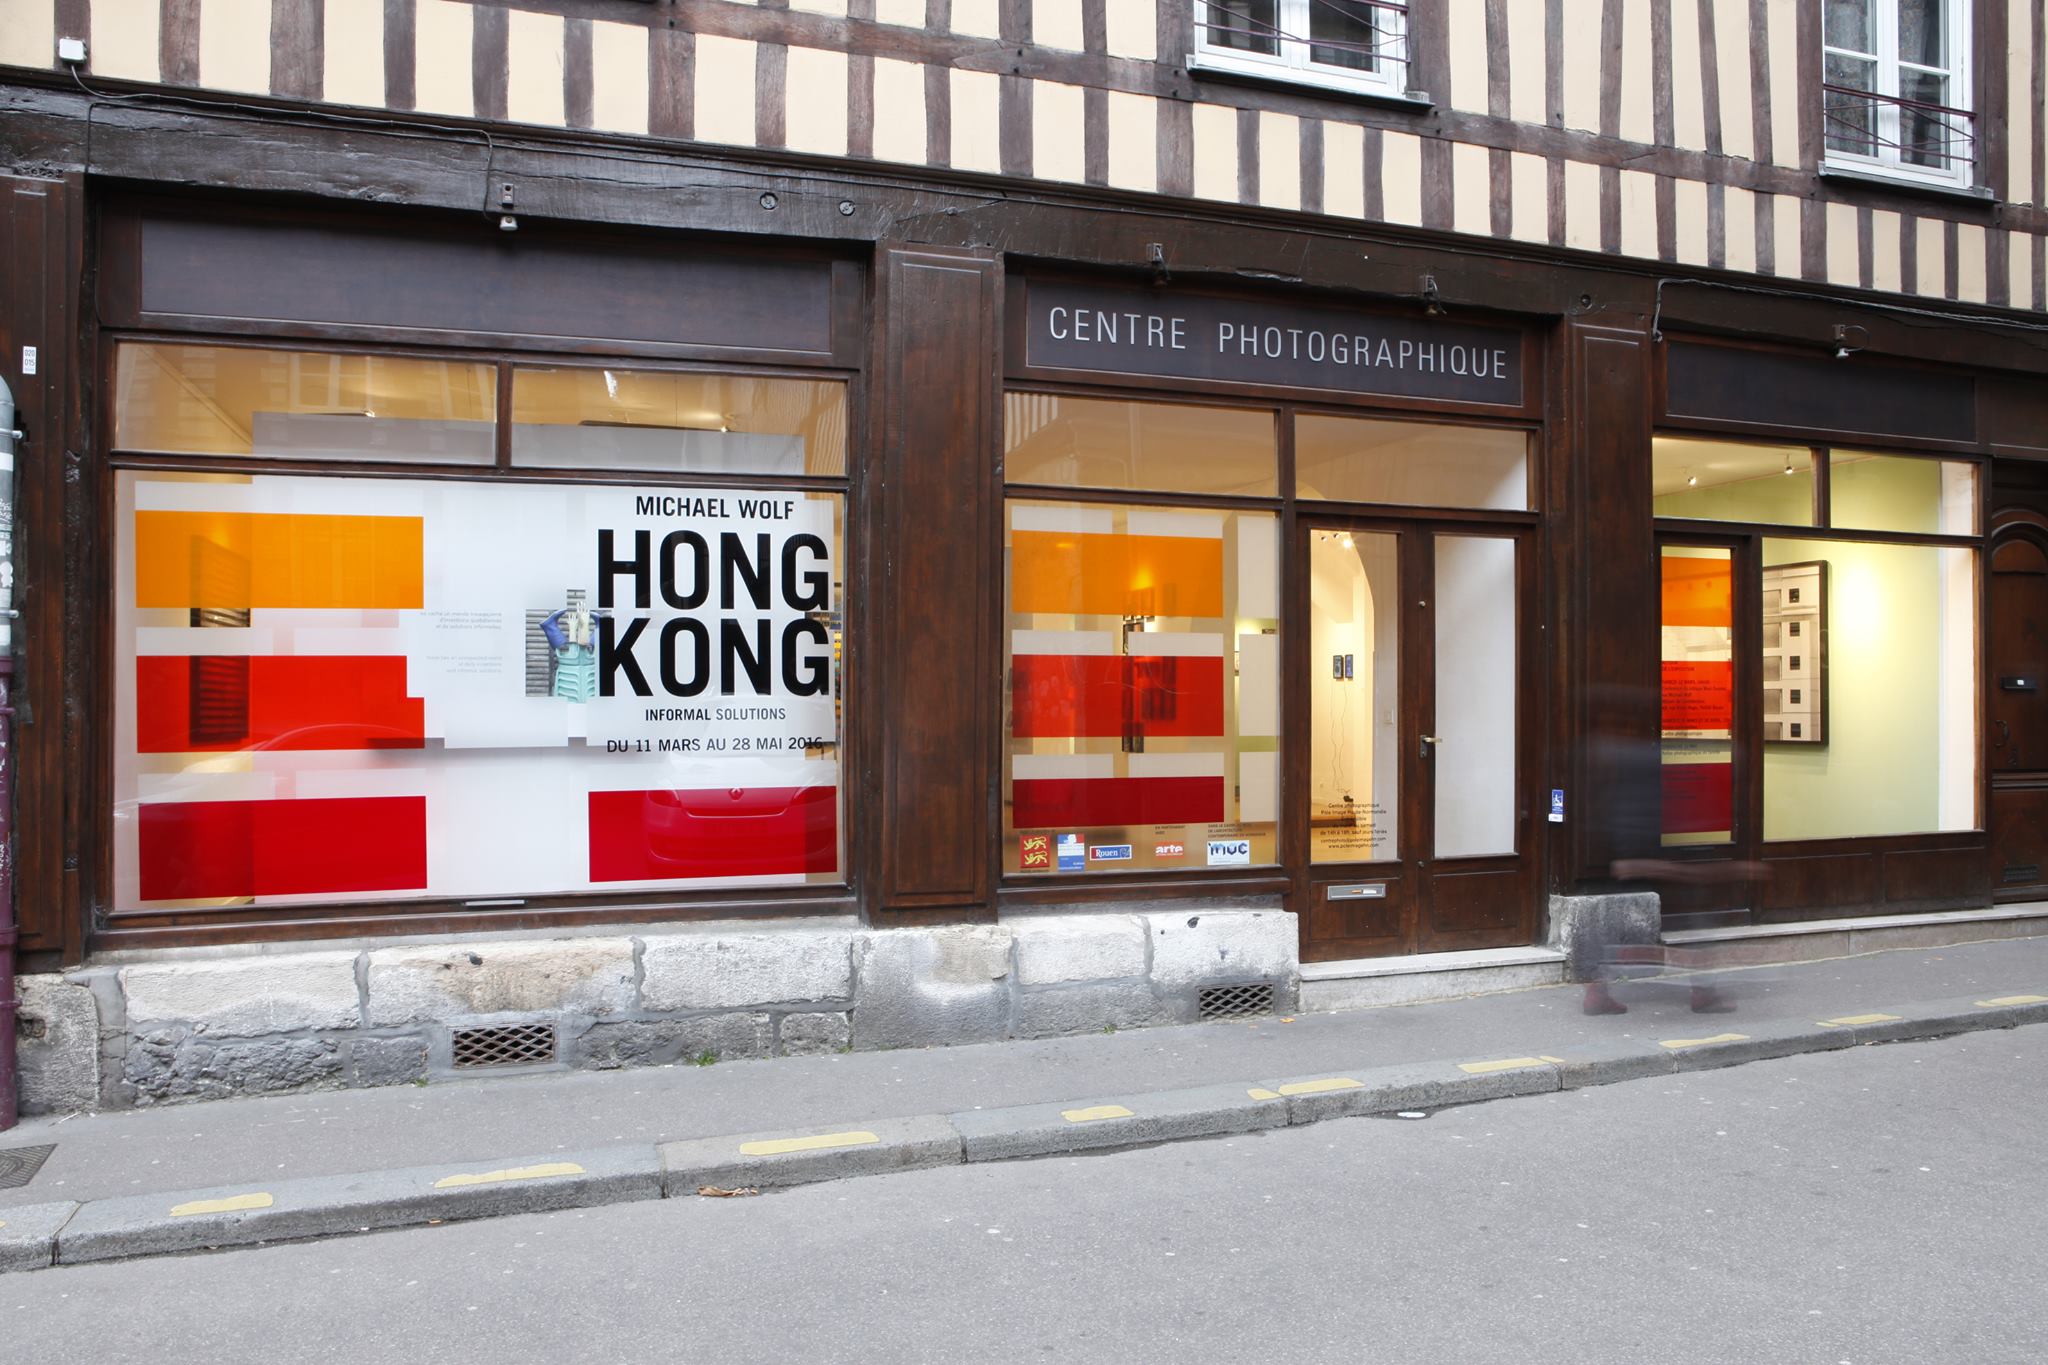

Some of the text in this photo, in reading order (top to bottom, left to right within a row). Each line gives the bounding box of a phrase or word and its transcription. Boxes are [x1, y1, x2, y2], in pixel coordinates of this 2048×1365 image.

[1049, 306, 1507, 380] CENTRE PHOTOGRAPHIQUE
[636, 495, 795, 520] MICHAEL WOLF
[597, 528, 829, 612] HONG
[598, 615, 830, 698] KONG
[645, 707, 786, 722] INFORMAL SOLUTIONS
[606, 736, 823, 753] DU 11 MARS AU 28 MAI 2016
[1096, 849, 1118, 858] Rouen
[1155, 844, 1184, 854] arte
